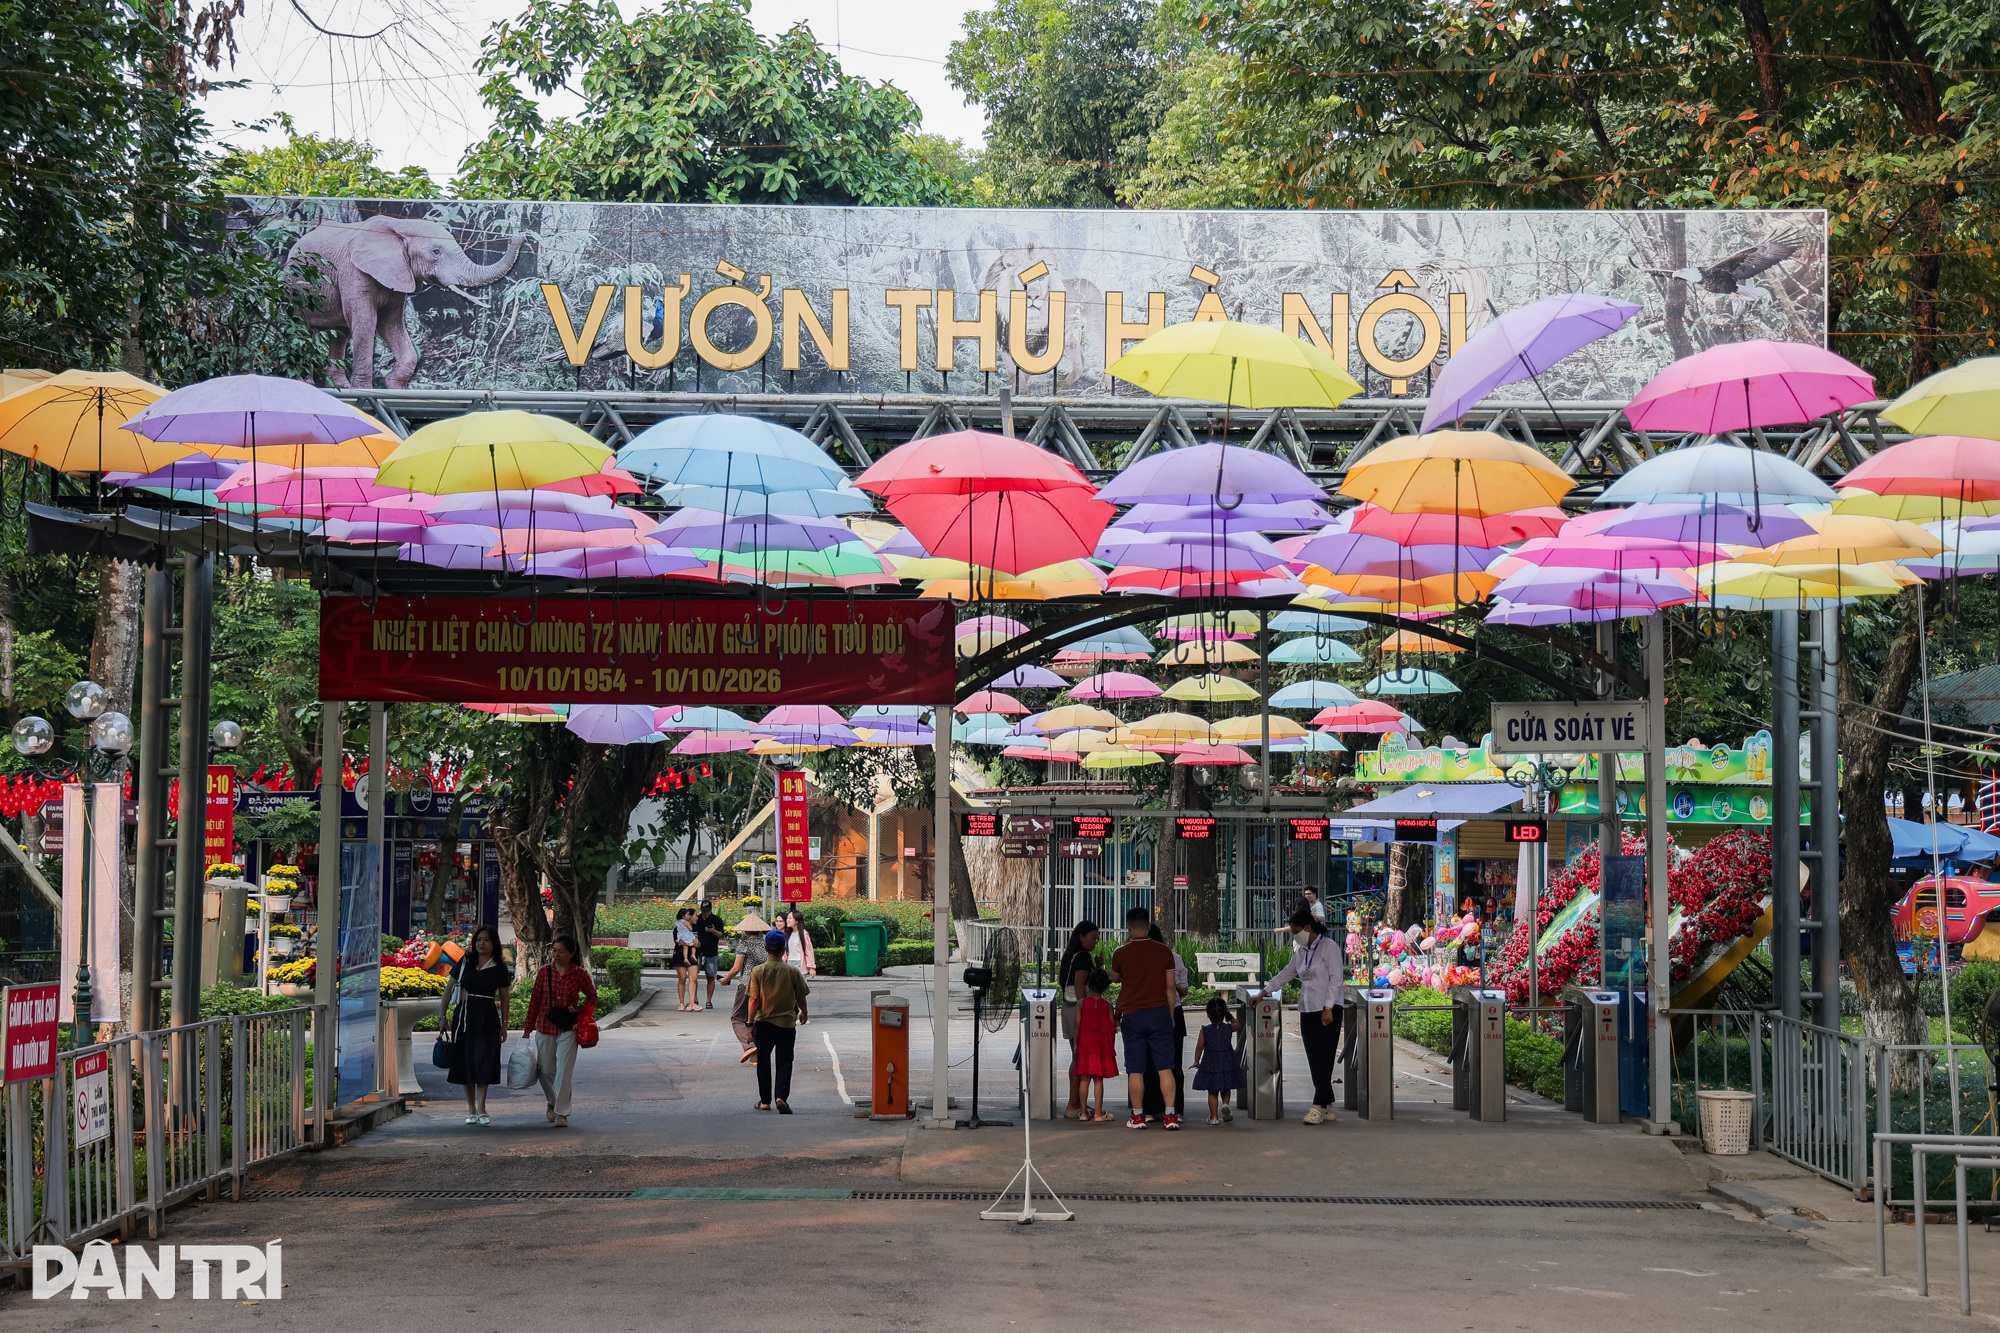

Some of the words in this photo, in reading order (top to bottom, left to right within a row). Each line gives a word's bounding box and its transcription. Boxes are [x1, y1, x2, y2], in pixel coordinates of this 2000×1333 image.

[541, 260, 850, 372] VƯỜN
[885, 260, 1066, 375] THÚ
[1282, 269, 1466, 395] NỘI
[373, 615, 427, 658] NHIỆT
[432, 615, 469, 658] LIỆT
[475, 615, 524, 653] CHÀO
[531, 615, 586, 653] MỪNG
[593, 623, 614, 654] 72
[620, 617, 661, 654] NĂM
[668, 616, 716, 654] NGÀY
[722, 613, 759, 654] GIẢI
[764, 616, 827, 654] PHÓNG
[832, 613, 867, 654] THỦ
[872, 617, 903, 654] ĐÔ!
[497, 667, 627, 692] 10/10/1954
[652, 668, 782, 693] 10/10/2026
[1507, 710, 1547, 742] CỬA
[1554, 713, 1605, 742] SOÁT
[1611, 712, 1635, 741] VÉ
[207, 775, 229, 794] 0-10
[412, 789, 430, 798] PEPSI
[783, 778, 803, 793] 10-10
[1513, 826, 1540, 840] LED
[9, 993, 22, 1027] CẤM
[34, 991, 45, 1024] THẢ
[45, 993, 56, 1022] CHÓ
